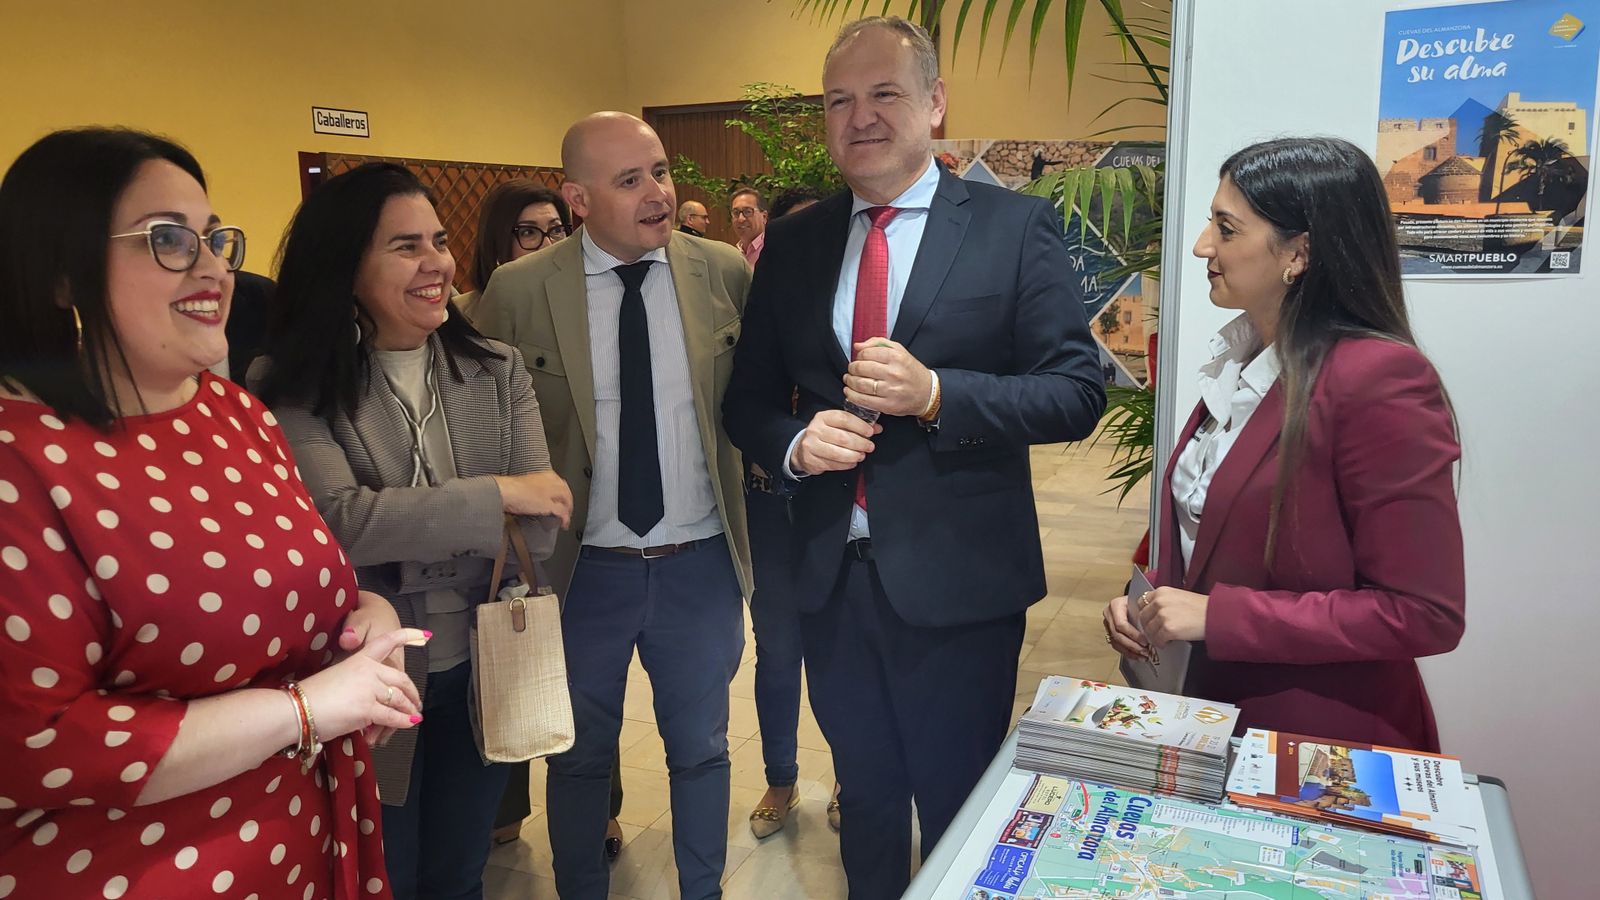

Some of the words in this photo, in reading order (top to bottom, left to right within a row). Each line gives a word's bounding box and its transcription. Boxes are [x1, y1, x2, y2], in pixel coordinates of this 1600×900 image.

[1396, 28, 1515, 65] Descubre
[1407, 65, 1434, 83] su
[1444, 55, 1508, 80] alma
[317, 111, 366, 129] Caballeros
[1112, 155, 1143, 168] CUEVAS
[1429, 253, 1517, 263] SMARTPUEBLO
[1413, 762, 1421, 772] sus
[1423, 759, 1432, 779] Cuevas
[1433, 760, 1444, 787] Descubre
[1415, 773, 1424, 793] museos
[1426, 780, 1435, 788] del
[1103, 791, 1120, 805] del
[1428, 789, 1439, 813] Almanzora
[1116, 796, 1152, 840] Cuevas
[1077, 805, 1119, 860] Almanzora
